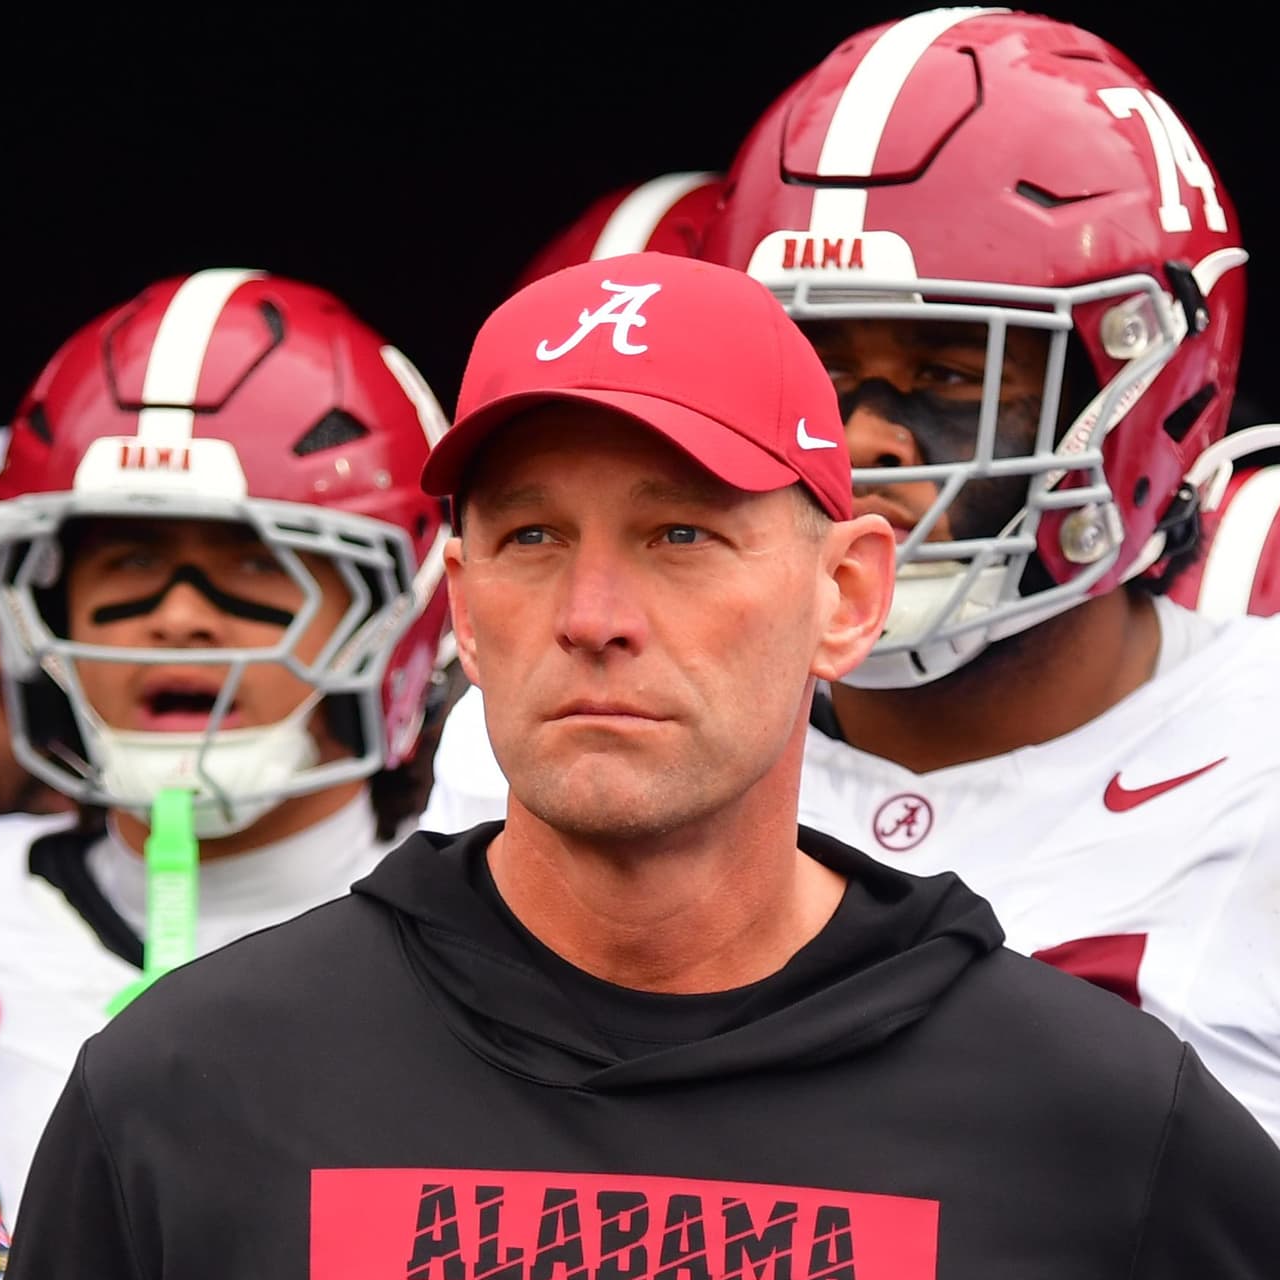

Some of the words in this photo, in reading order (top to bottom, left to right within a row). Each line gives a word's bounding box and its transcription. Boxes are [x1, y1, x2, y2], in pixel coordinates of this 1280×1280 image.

[1096, 86, 1228, 233] 74
[782, 238, 863, 269] BAMA
[535, 279, 662, 361] A
